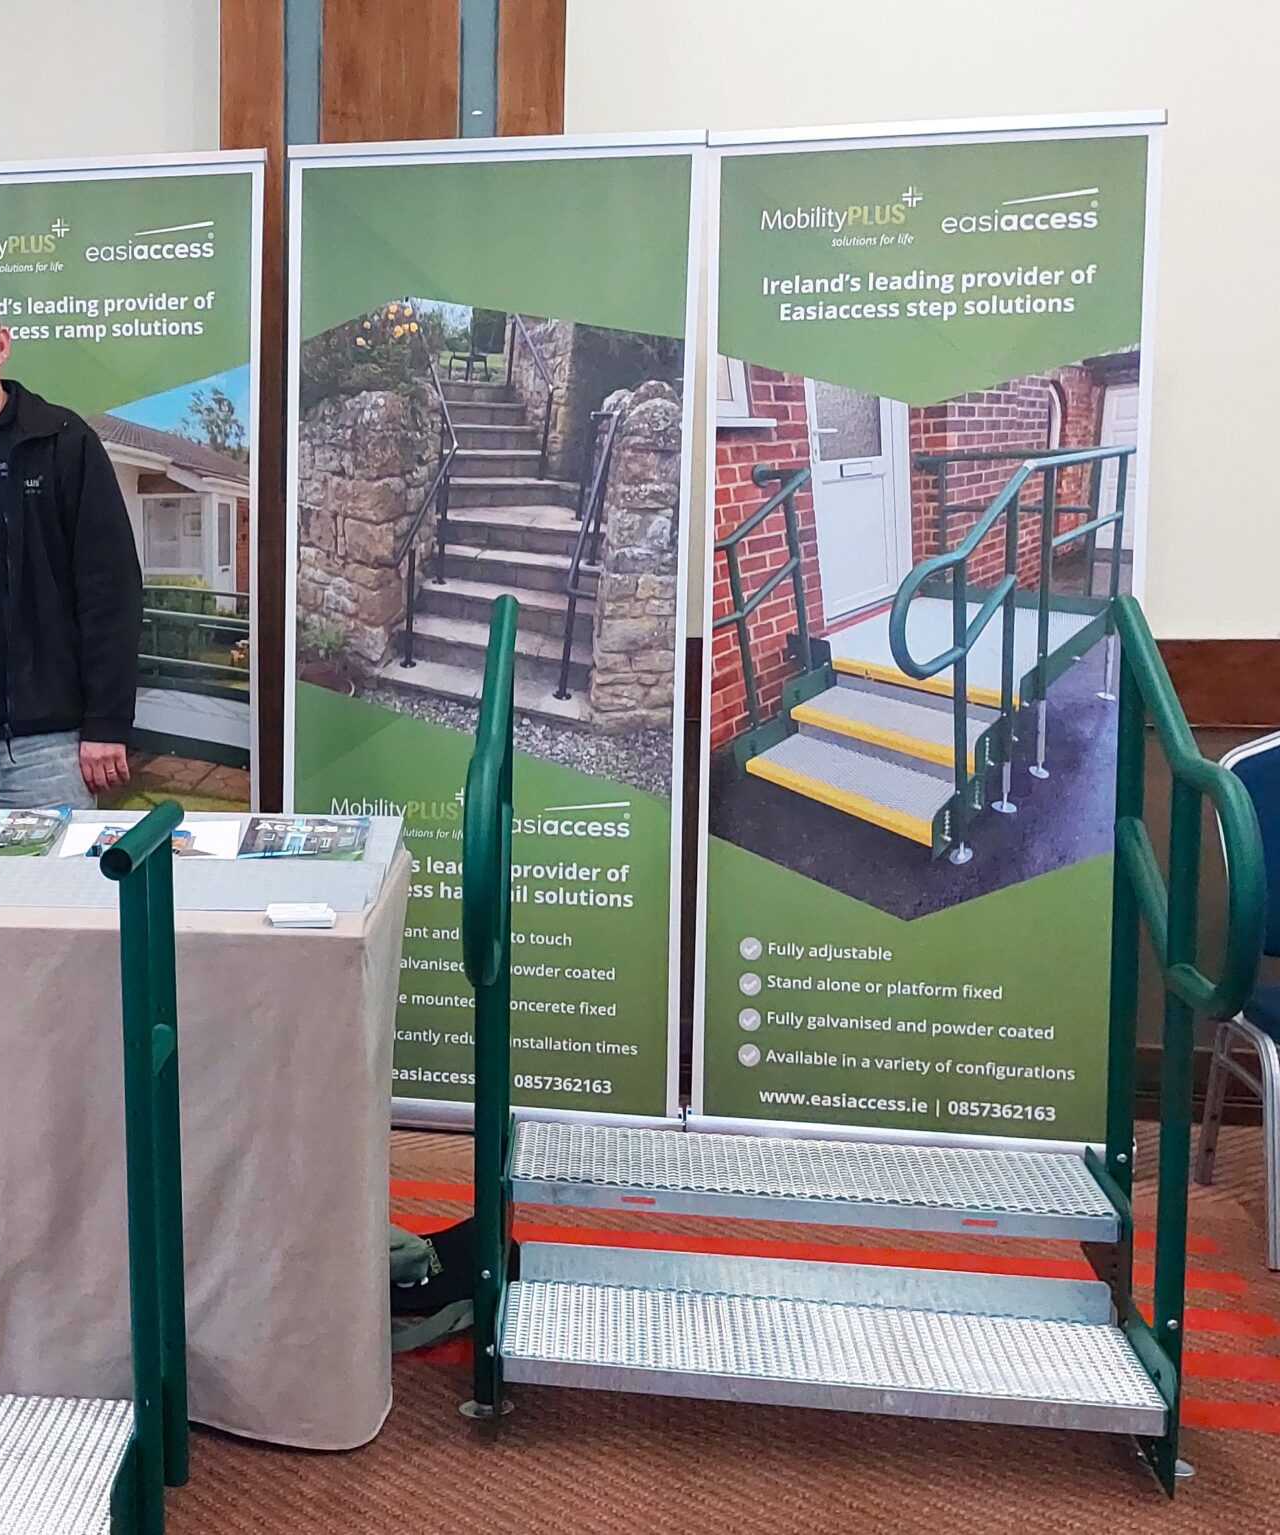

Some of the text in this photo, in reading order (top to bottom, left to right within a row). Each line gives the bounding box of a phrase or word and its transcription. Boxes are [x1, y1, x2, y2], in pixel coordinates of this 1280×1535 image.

[760, 204, 906, 232] MobilityPLUS
[940, 208, 1099, 234] easiaccess
[84, 236, 215, 262] easiaccess
[831, 233, 914, 247] solutions for life
[36, 262, 48, 273] for
[50, 262, 64, 272] life
[762, 265, 1097, 296] Ireland's leading provider of
[27, 296, 99, 317] leading
[104, 293, 187, 316] provider
[192, 292, 215, 311] of
[779, 295, 1075, 321] Easiaccess step solutions
[54, 323, 107, 343] ramp
[111, 318, 204, 338] solutions
[401, 827, 434, 838] lutions
[436, 828, 449, 840] for
[511, 862, 630, 886] provider of
[534, 889, 634, 908] solutions
[432, 928, 459, 940] and
[511, 931, 525, 944] to
[530, 932, 572, 947] touch
[768, 942, 893, 963] Fully adjustable
[511, 966, 560, 978] owder
[564, 966, 616, 981] coated
[767, 974, 1003, 1000] Stand alone or platform fixed
[510, 1000, 576, 1014] oncerete
[579, 1000, 617, 1017] fixed
[766, 1010, 1054, 1040] Fully galvanised and powder coated
[597, 1039, 639, 1055] times
[765, 1048, 1076, 1081] Available in a variety of configurations
[514, 1074, 613, 1094] 0857362163
[758, 1089, 928, 1113] www.easiaccess.ie
[947, 1098, 1057, 1121] 0857362163
